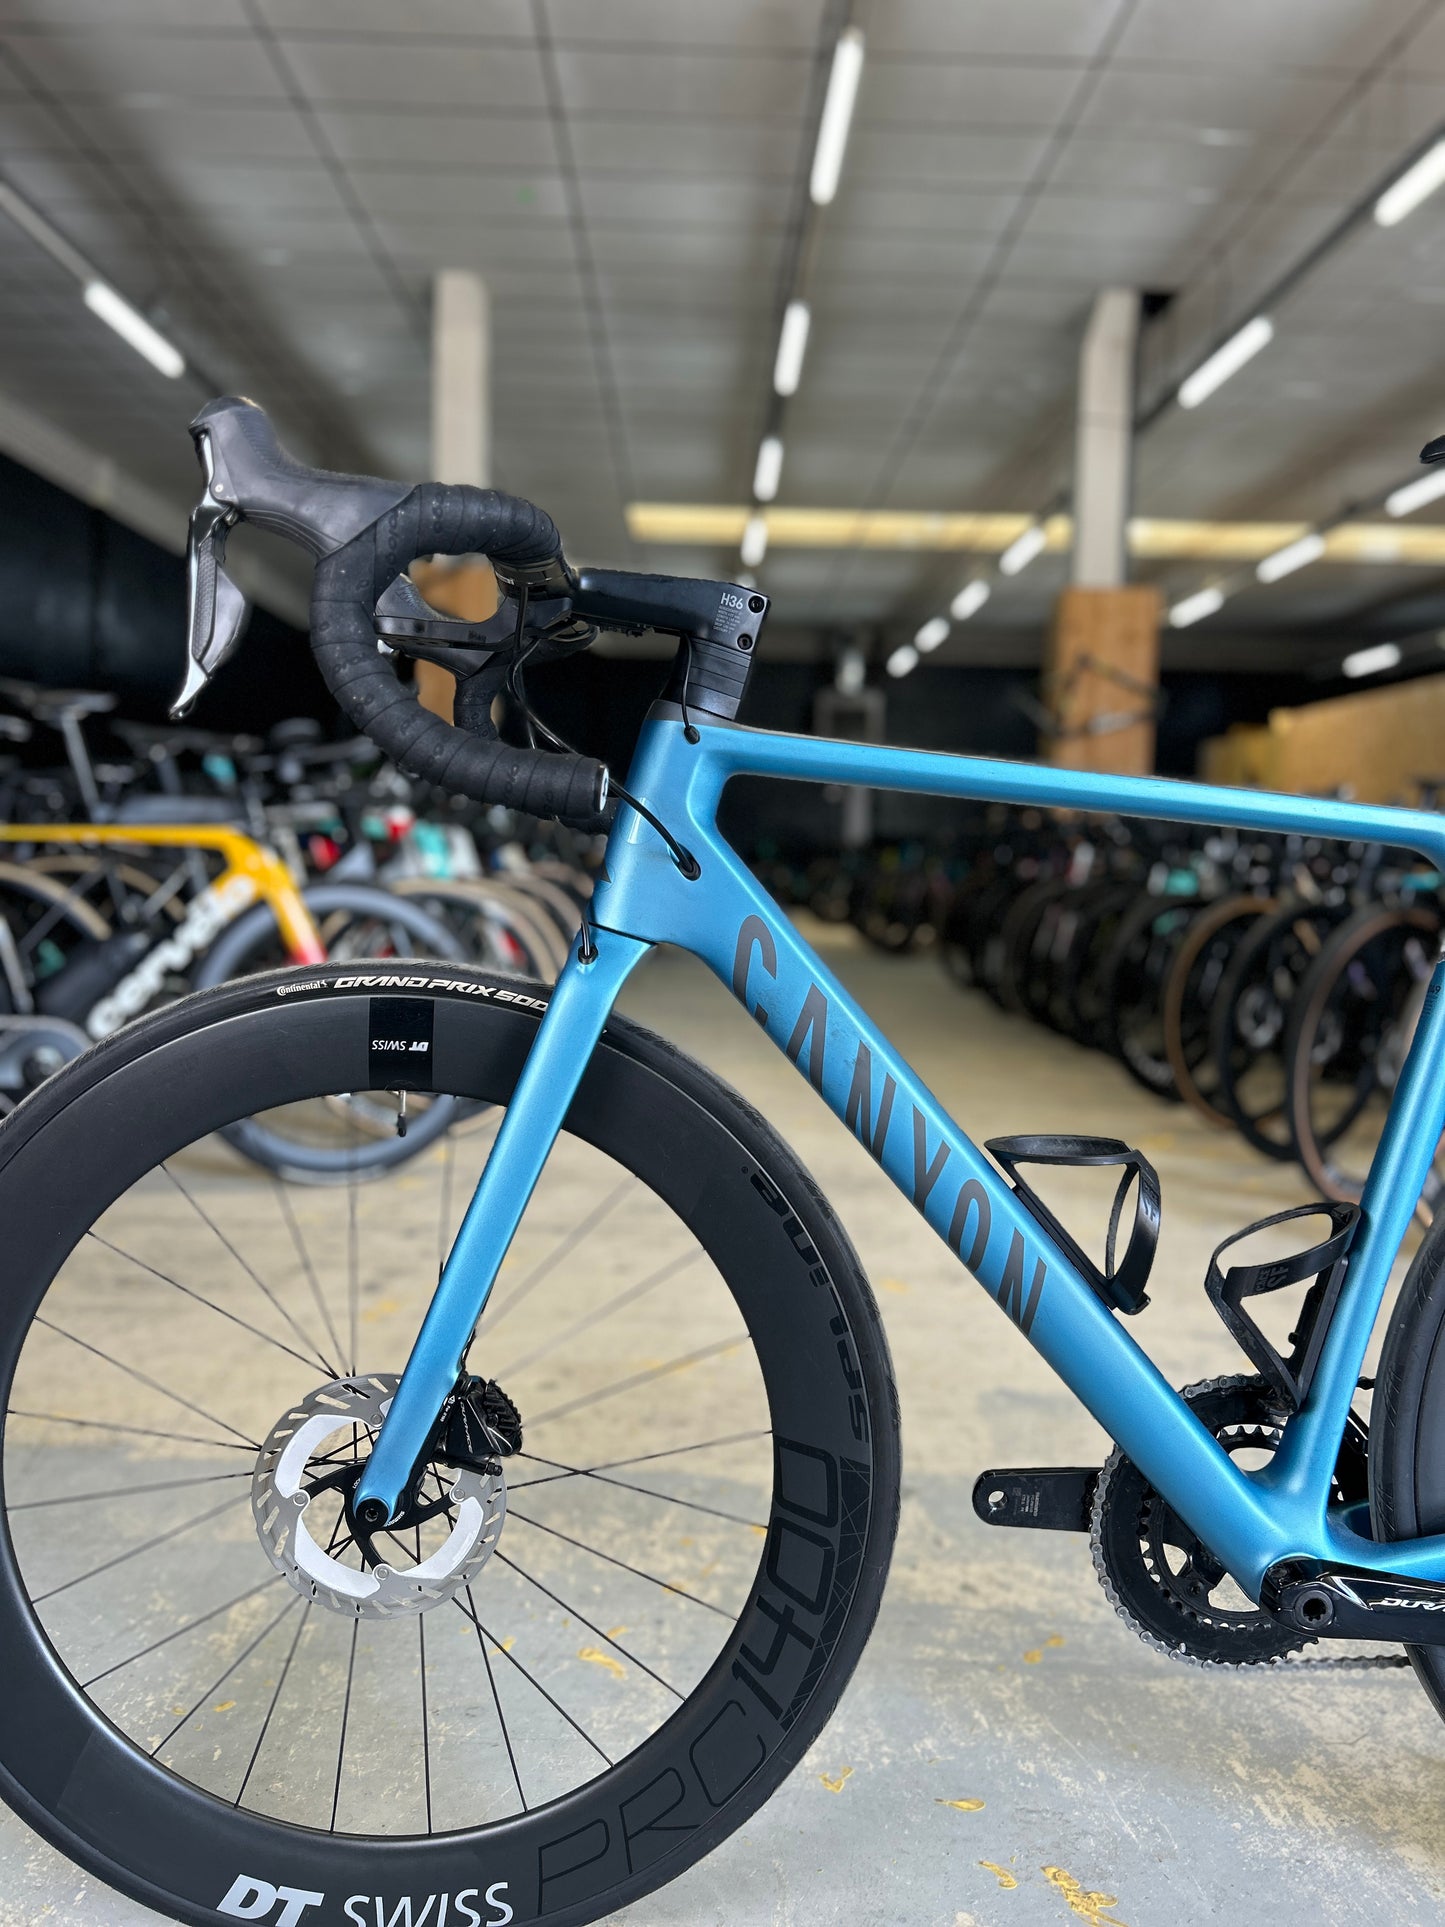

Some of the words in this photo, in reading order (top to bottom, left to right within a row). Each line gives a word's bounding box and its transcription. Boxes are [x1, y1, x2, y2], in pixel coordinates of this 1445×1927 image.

[720, 592, 744, 610] H36
[276, 980, 321, 997] Continental
[333, 975, 433, 989] GRAND
[427, 978, 498, 998] PRIX
[372, 1039, 406, 1051] SWISS
[408, 1041, 429, 1052] DT
[732, 914, 1047, 1338] CANYON
[216, 1873, 325, 1927] DT
[343, 1881, 514, 1927] SWISS
